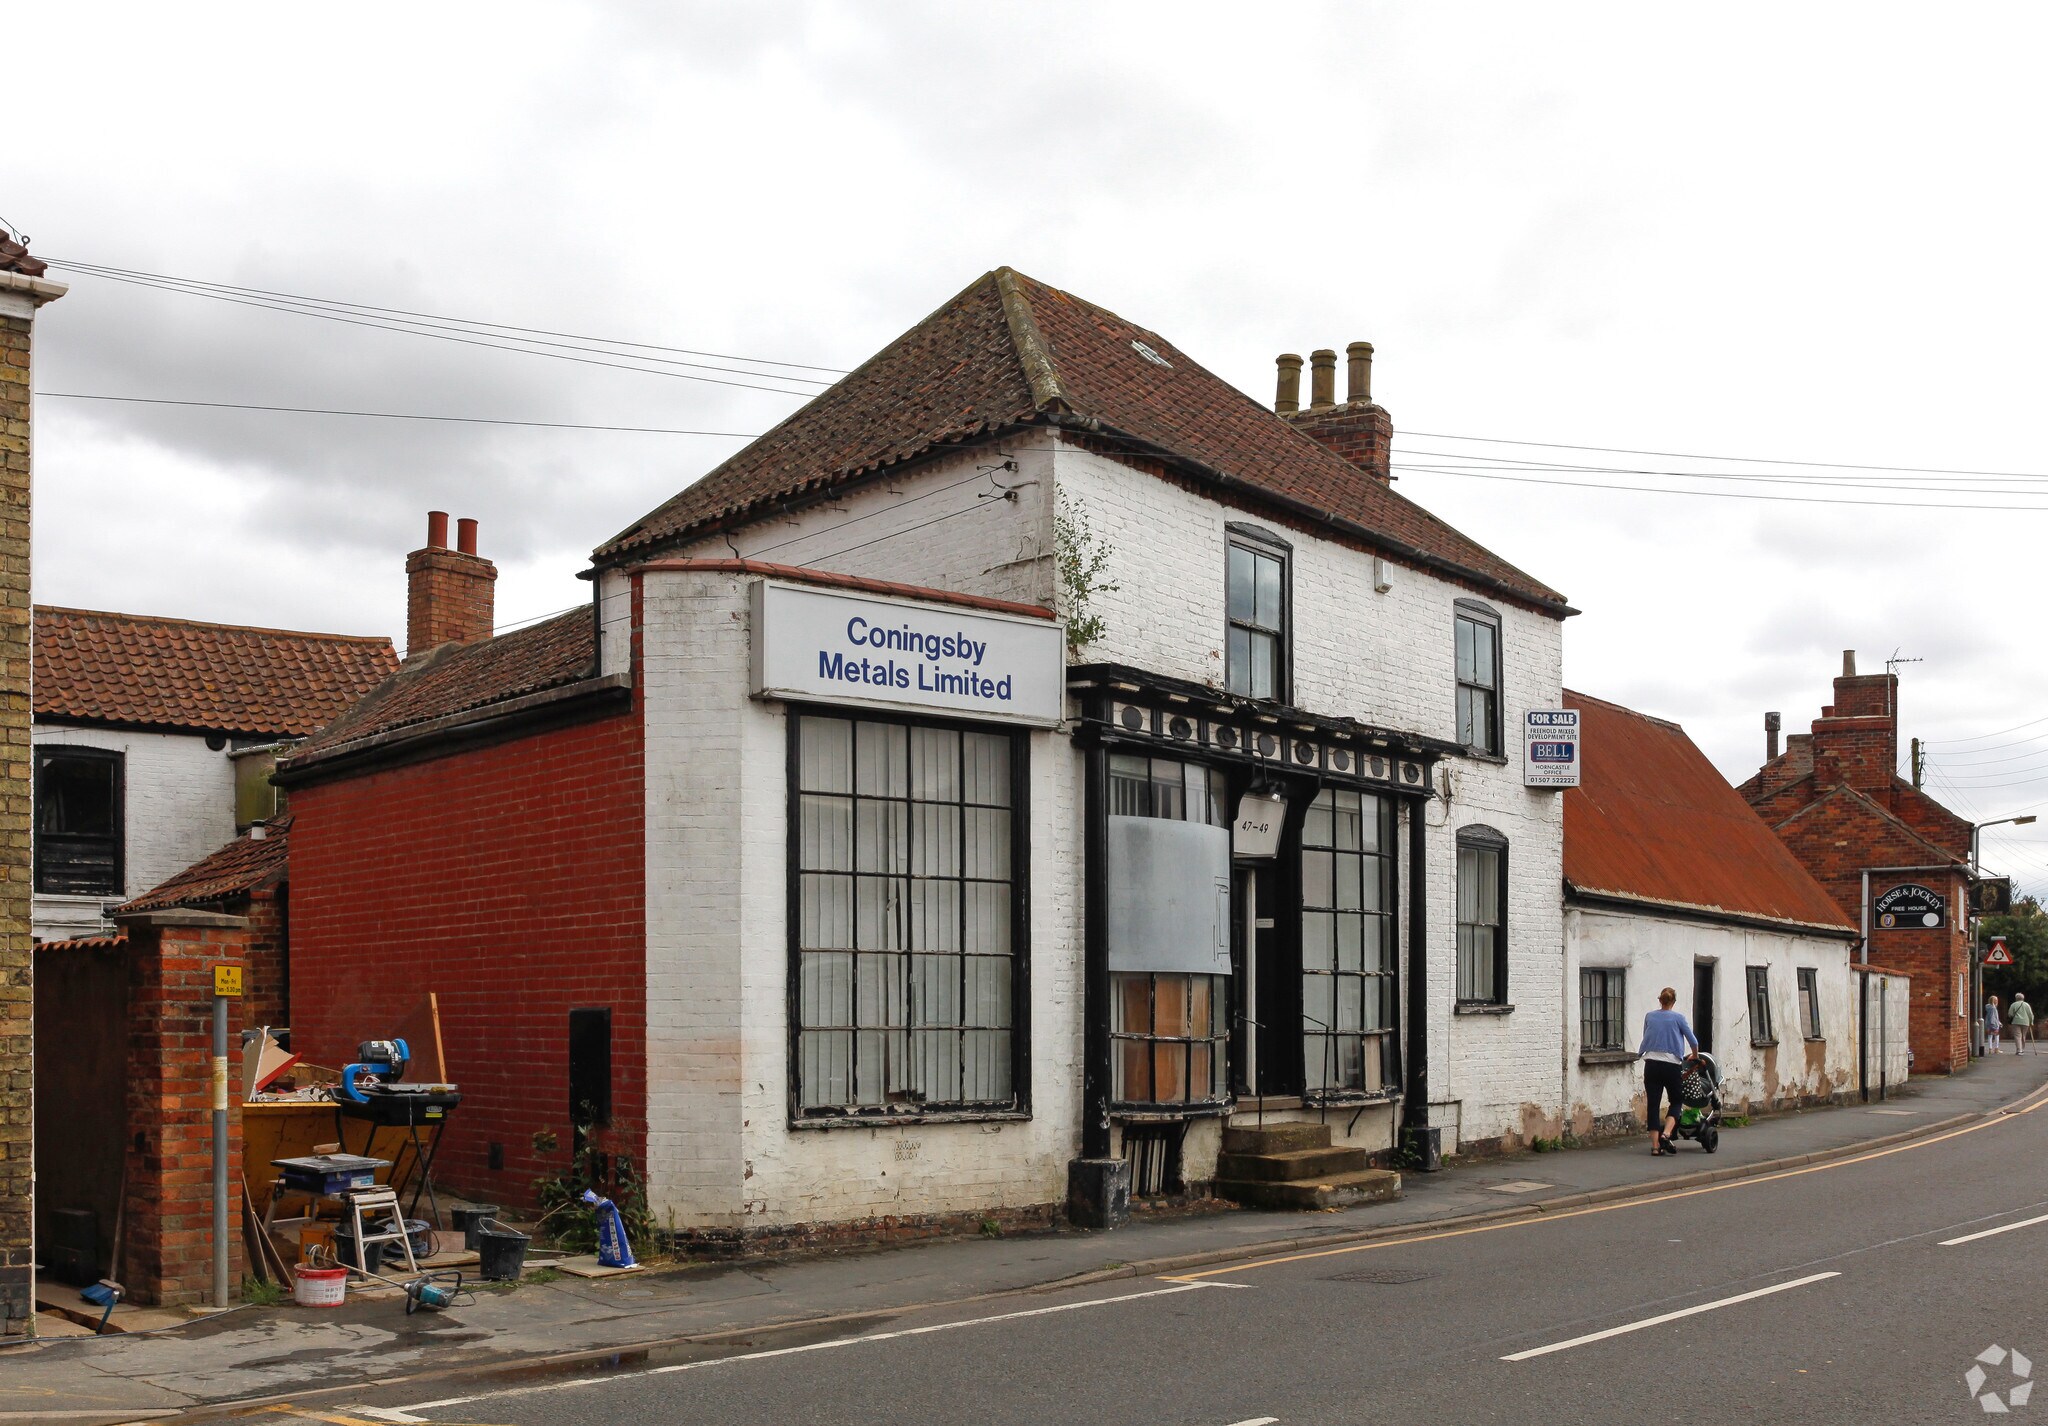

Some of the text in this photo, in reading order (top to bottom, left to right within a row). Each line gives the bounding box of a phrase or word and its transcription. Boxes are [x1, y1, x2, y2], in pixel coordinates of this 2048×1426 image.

[847, 616, 987, 665] Coningsby
[818, 650, 1012, 701] Metals Limited
[1531, 713, 1574, 725] FOR SALE
[1536, 744, 1569, 758] BELL
[1242, 821, 1269, 834] 47-49
[1876, 887, 1943, 912] HORSE & JOCKEY
